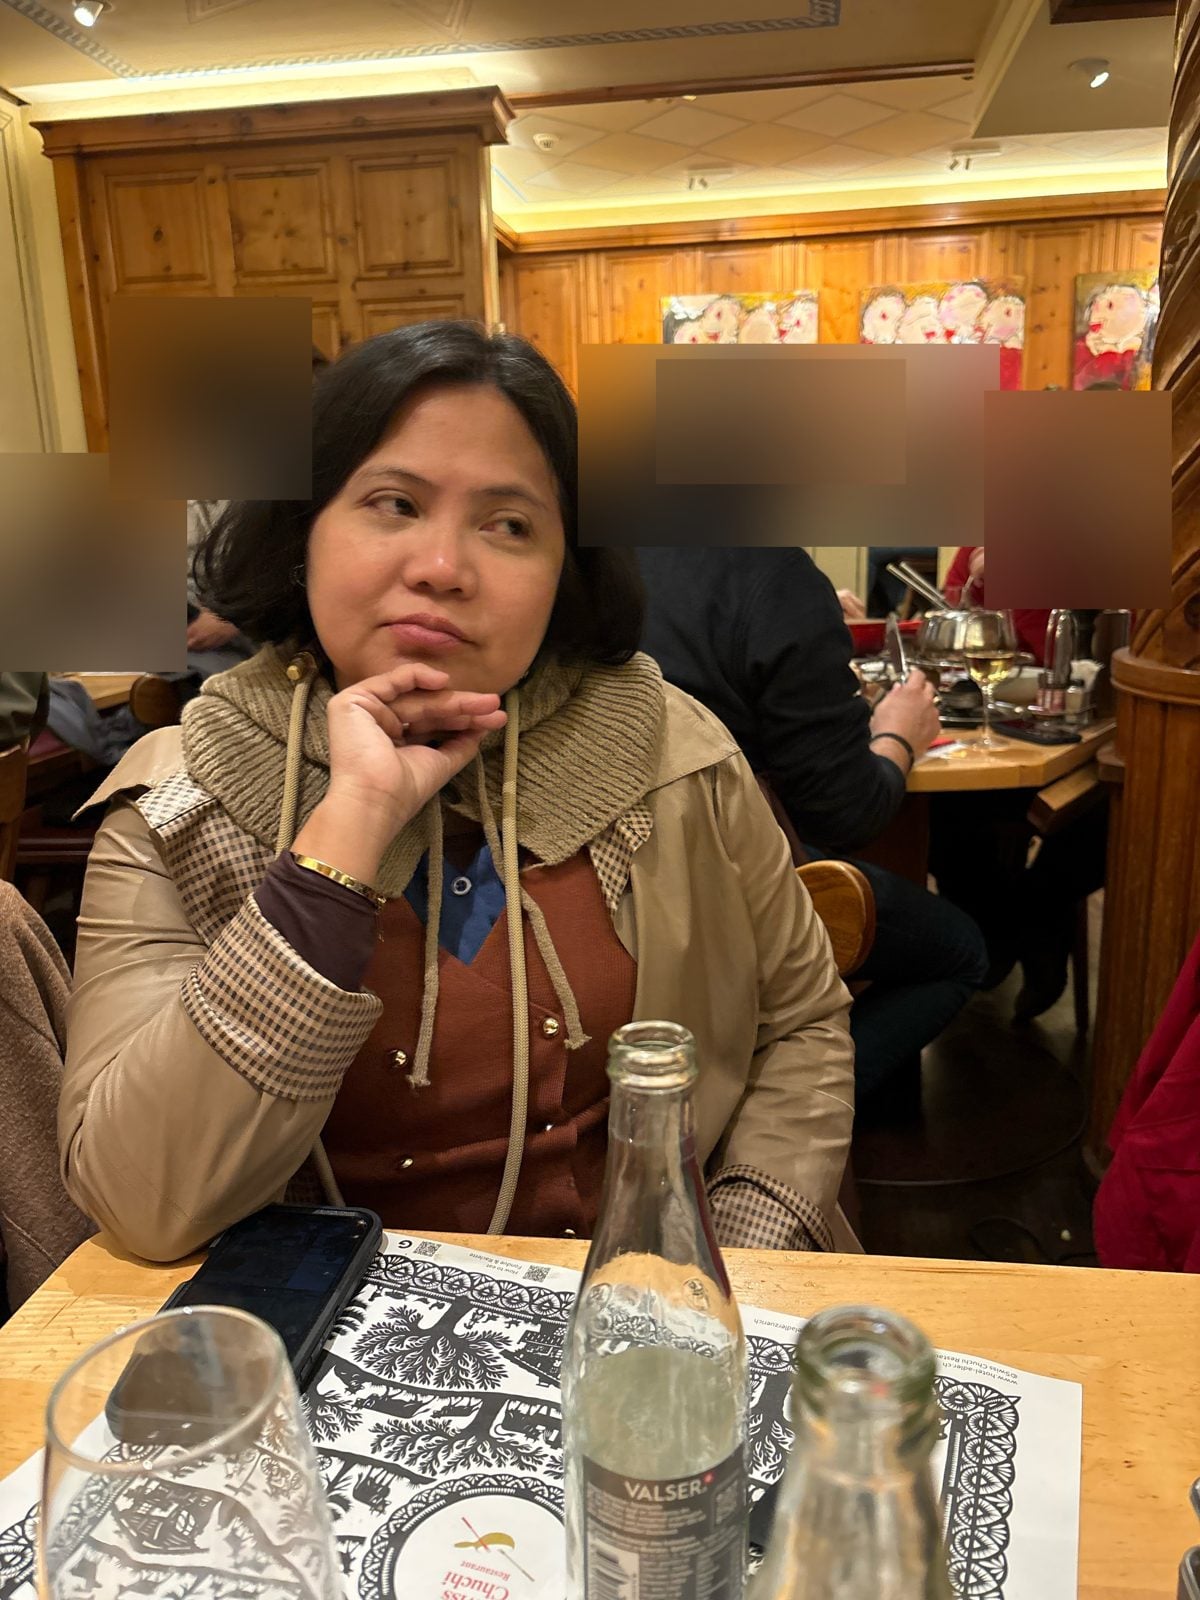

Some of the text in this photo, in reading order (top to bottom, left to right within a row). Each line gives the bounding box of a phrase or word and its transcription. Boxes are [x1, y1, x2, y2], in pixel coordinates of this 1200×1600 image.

[398, 1240, 412, 1249] G
[469, 1253, 494, 1263] Raclette
[500, 1261, 523, 1270] Fondue
[753, 1319, 801, 1333] eladlerzuerich
[962, 1359, 987, 1370] Chuchi
[942, 1362, 1018, 1385] www.hotel-adler.ch
[624, 1479, 703, 1502] VALSER
[460, 1561, 511, 1582] Restaurant
[442, 1572, 509, 1600] Chuchi
